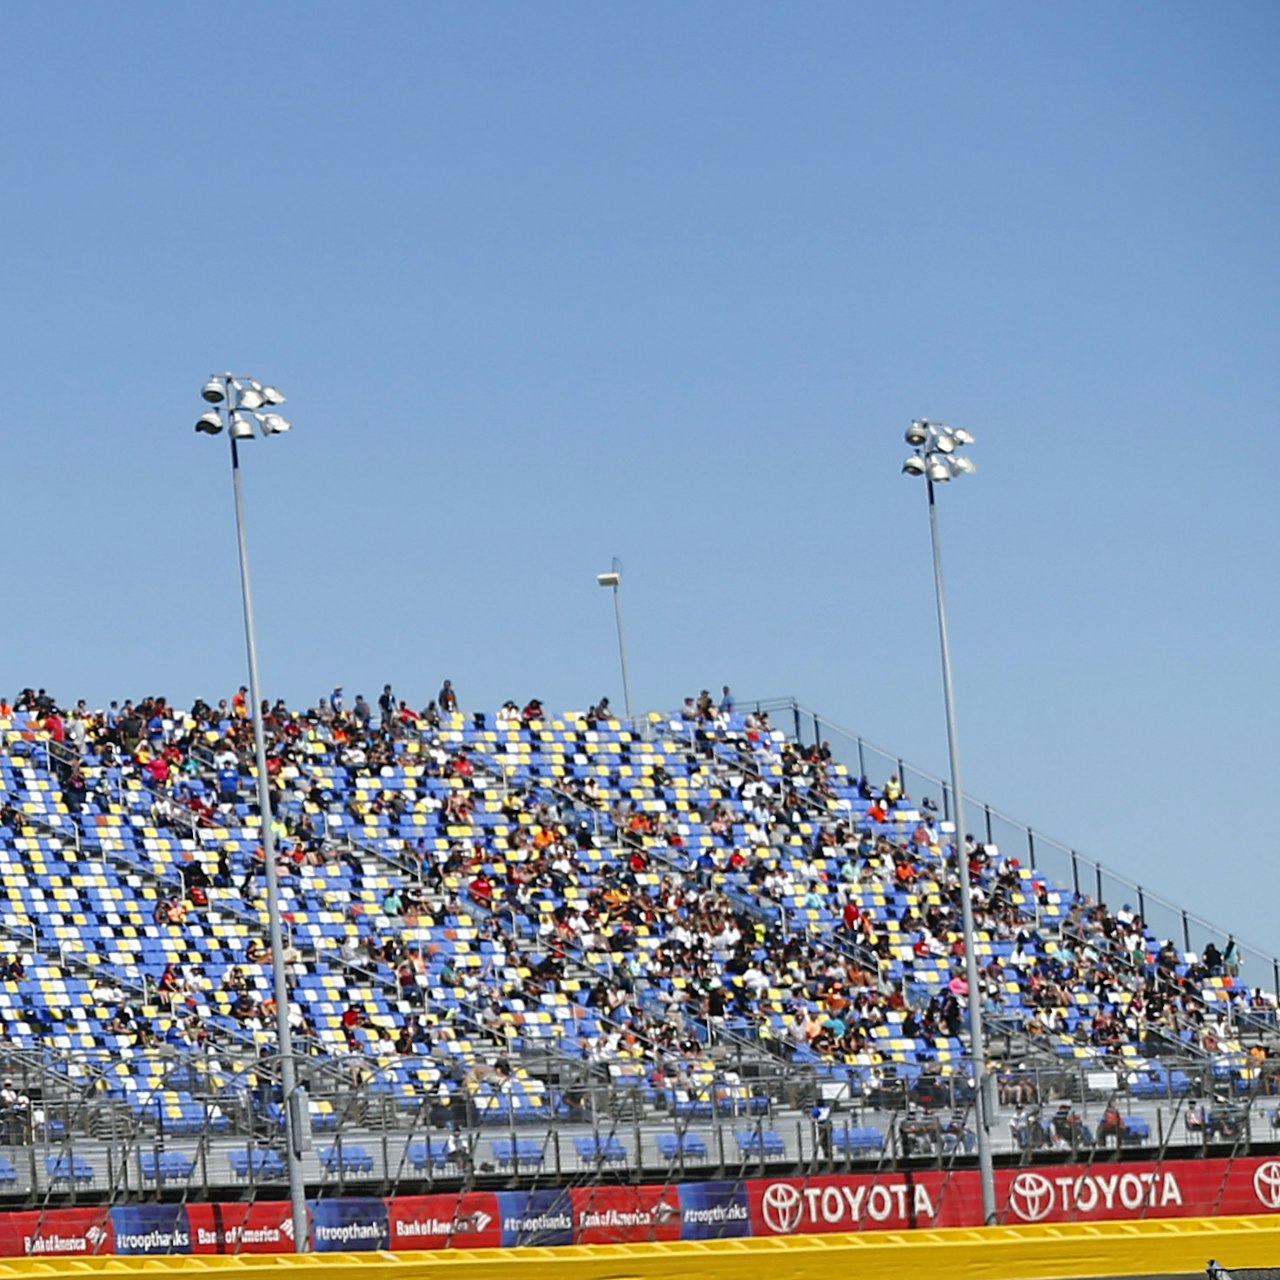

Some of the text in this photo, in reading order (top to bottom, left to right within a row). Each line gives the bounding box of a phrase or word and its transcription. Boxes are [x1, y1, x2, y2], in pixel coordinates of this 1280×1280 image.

[1057, 1173, 1183, 1212] TOYOTA
[804, 1184, 934, 1222] TOYOTA
[609, 1209, 650, 1226] America
[225, 1227, 237, 1243] of
[237, 1226, 279, 1243] America
[396, 1219, 421, 1236] Bank
[421, 1219, 431, 1235] of
[54, 1235, 87, 1251] America
